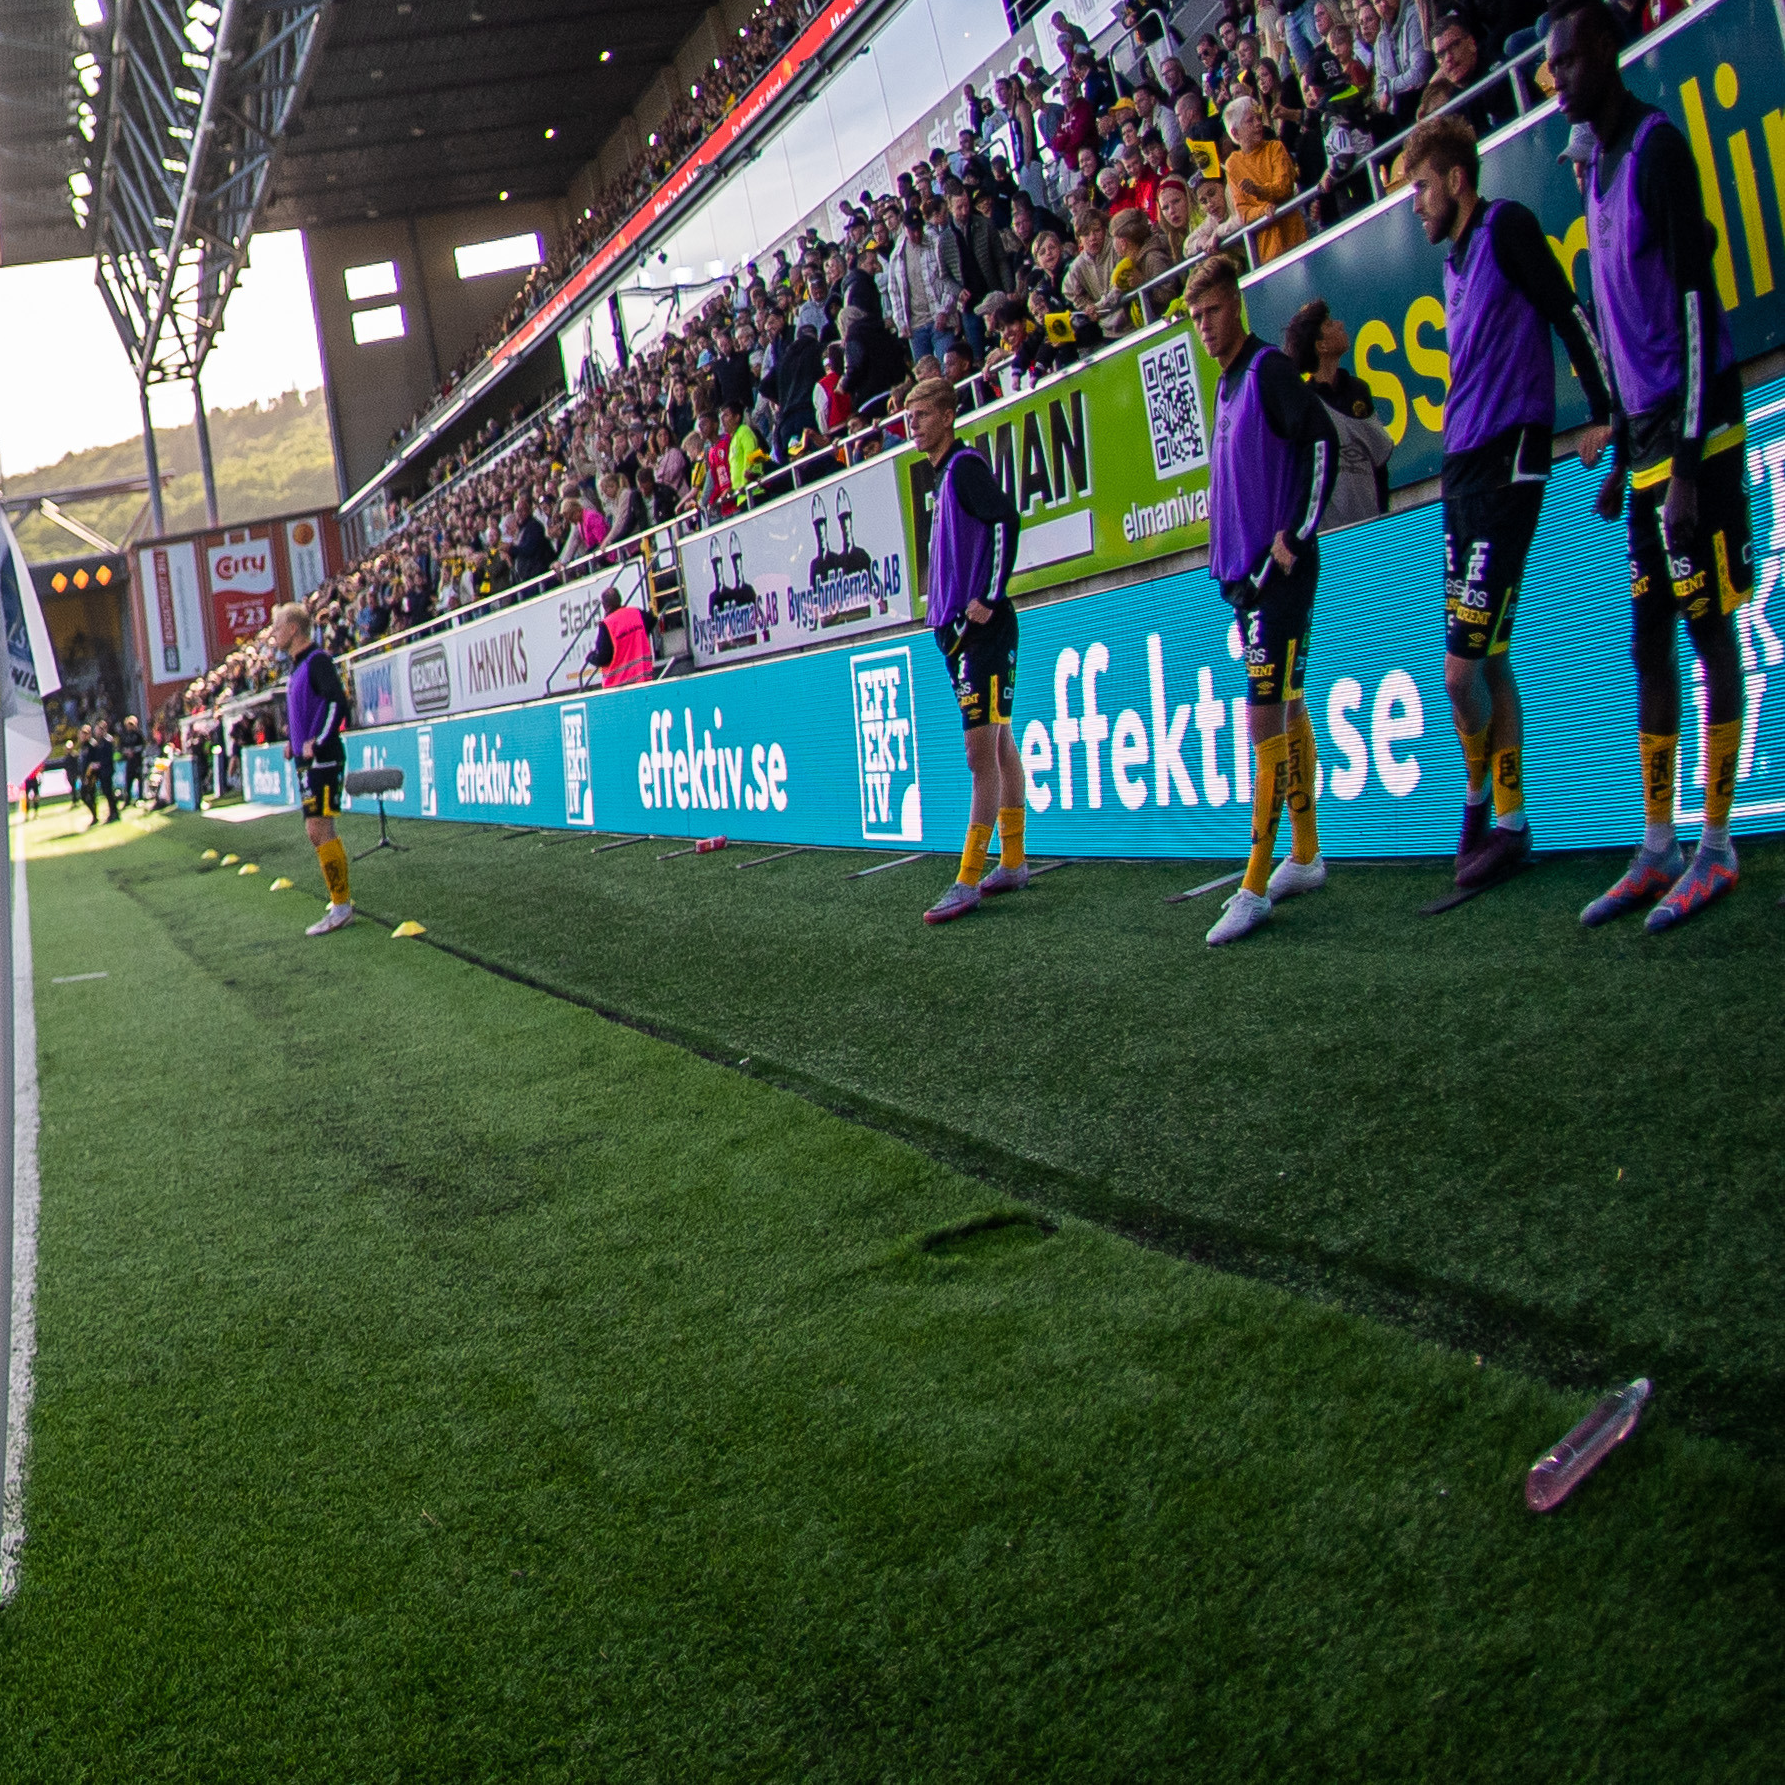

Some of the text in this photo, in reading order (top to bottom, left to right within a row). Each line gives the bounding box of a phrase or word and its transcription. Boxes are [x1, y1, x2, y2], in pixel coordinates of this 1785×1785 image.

[856, 664, 903, 721] EFF
[456, 733, 531, 807] effektiv.se
[637, 706, 788, 812] effektiv.se
[862, 717, 910, 772] EKT
